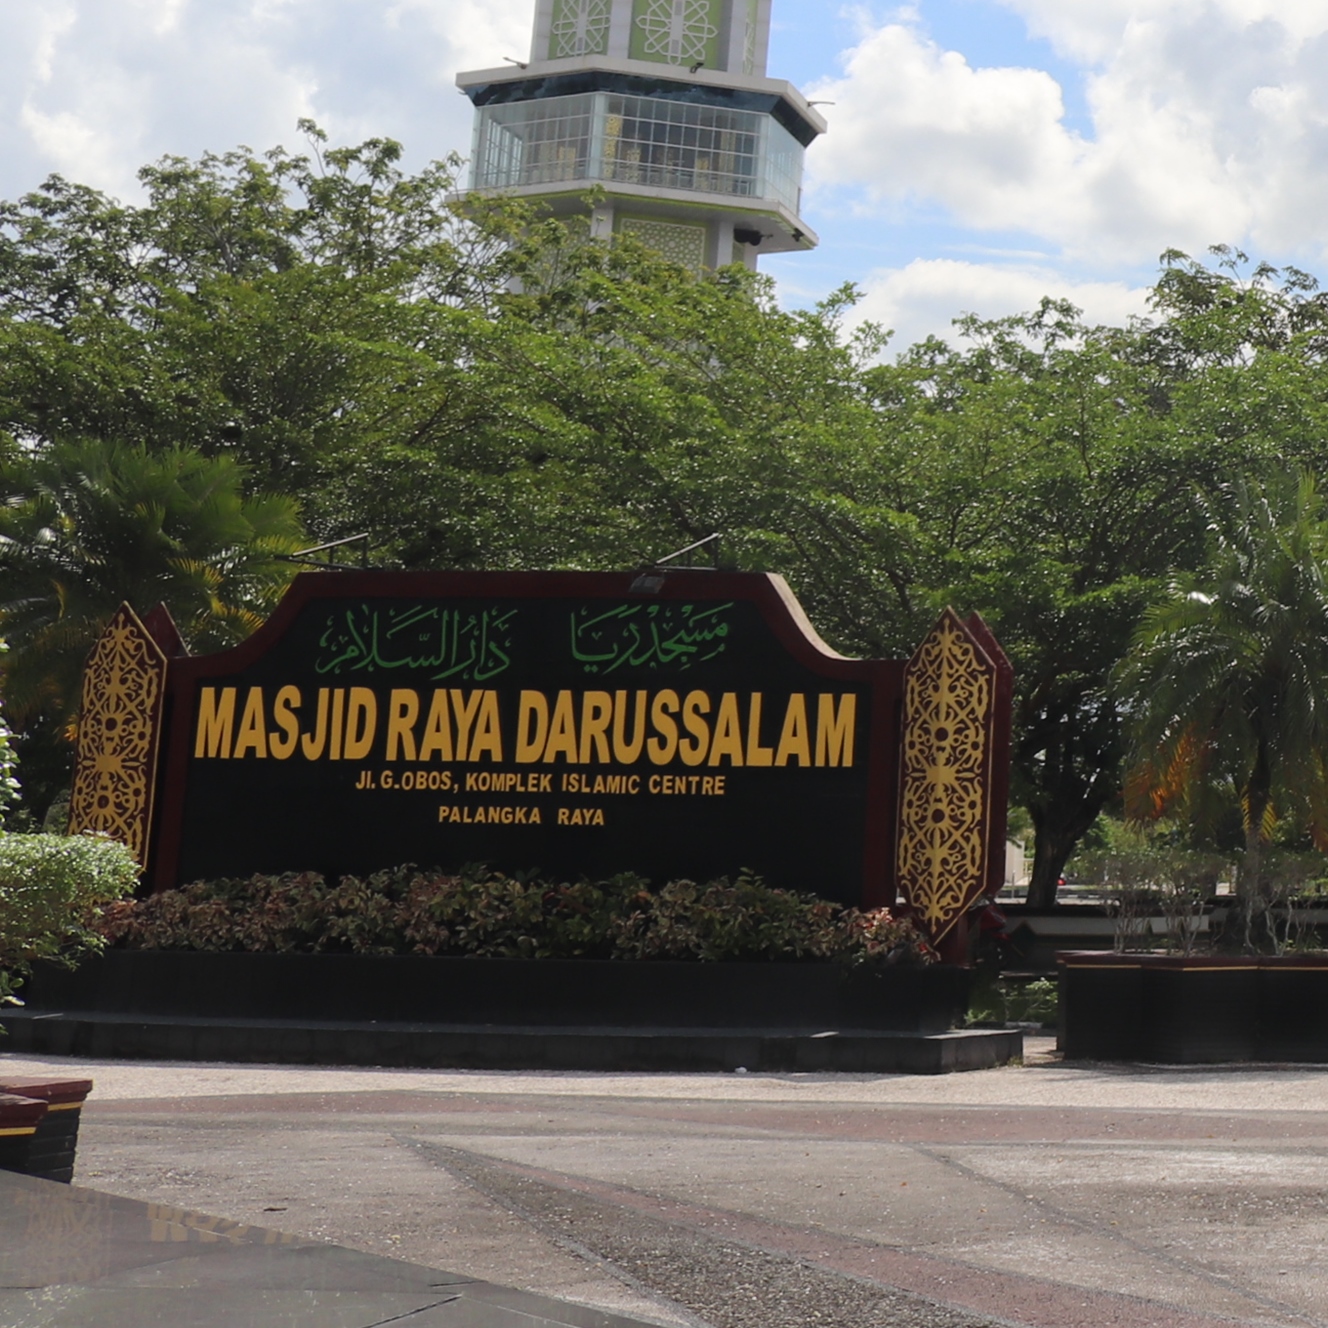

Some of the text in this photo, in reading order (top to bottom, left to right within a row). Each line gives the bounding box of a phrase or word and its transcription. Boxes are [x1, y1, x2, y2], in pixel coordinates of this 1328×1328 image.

[194, 684, 857, 768] MASJID RAYA DARUSSALAM
[465, 772, 554, 793] KOMPLEK
[562, 773, 641, 795] ISLAMIC
[648, 775, 727, 796] CENTRE
[438, 805, 605, 826] PALANGKA RAYA
